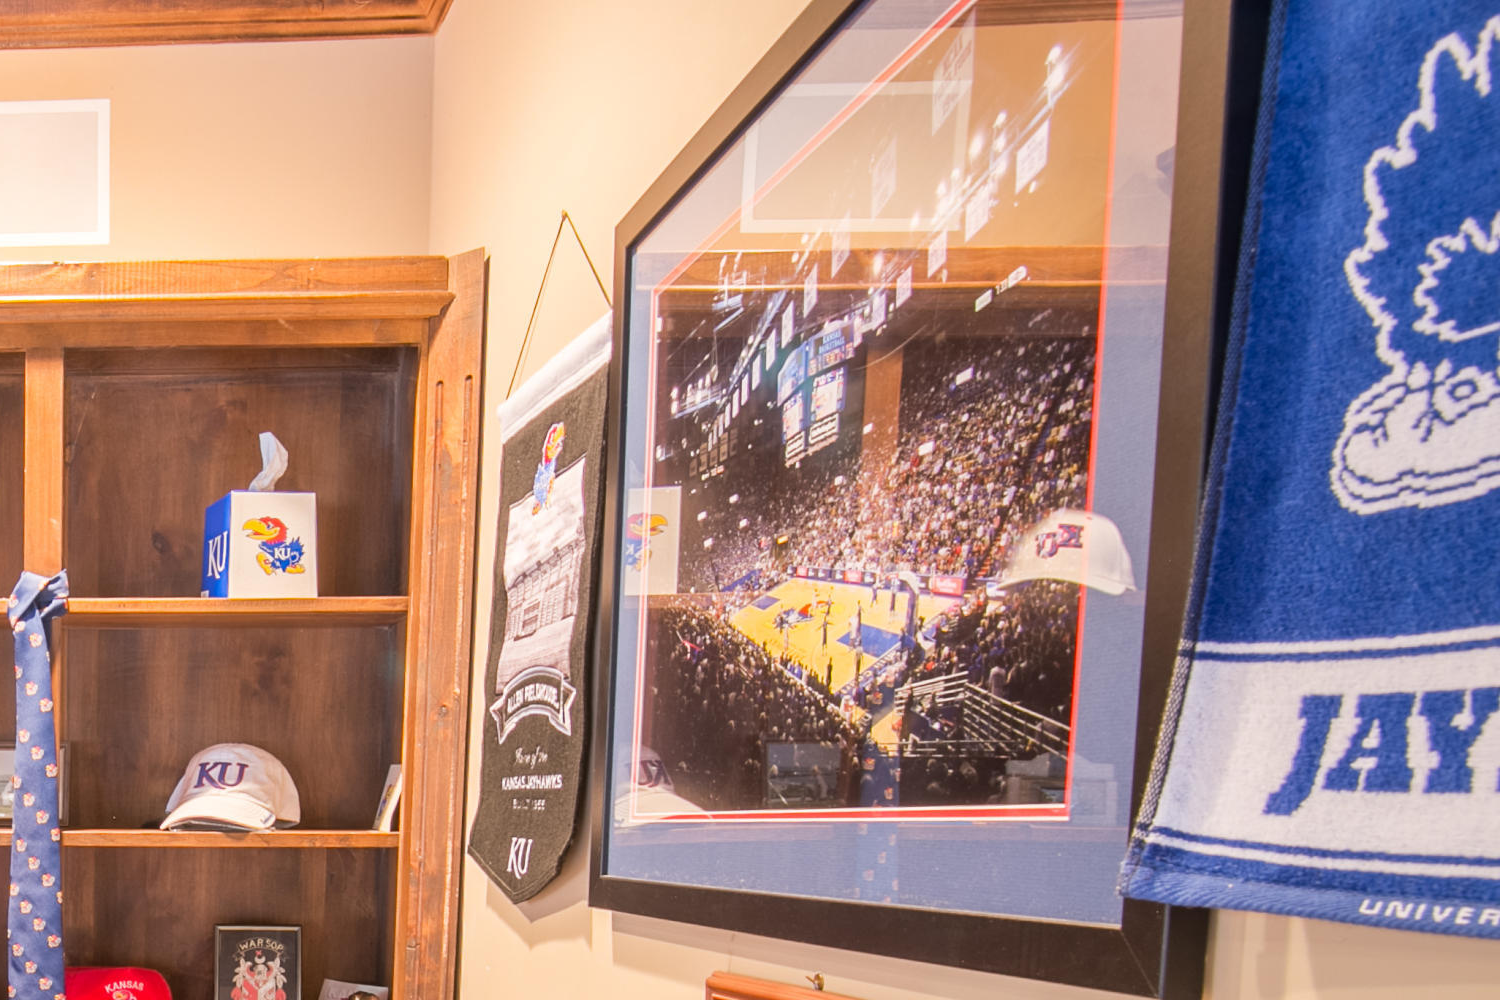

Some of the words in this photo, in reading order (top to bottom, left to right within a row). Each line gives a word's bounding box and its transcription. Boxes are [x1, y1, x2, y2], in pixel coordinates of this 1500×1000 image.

[207, 531, 228, 579] KU
[274, 547, 291, 560] KU
[1262, 686, 1500, 816] JAY
[193, 762, 249, 789] KU
[501, 776, 525, 790] KANSAS
[507, 837, 533, 880] KU
[1359, 897, 1500, 928] UNIVER
[239, 938, 284, 952] WARSOP
[104, 980, 145, 993] KANSAS
